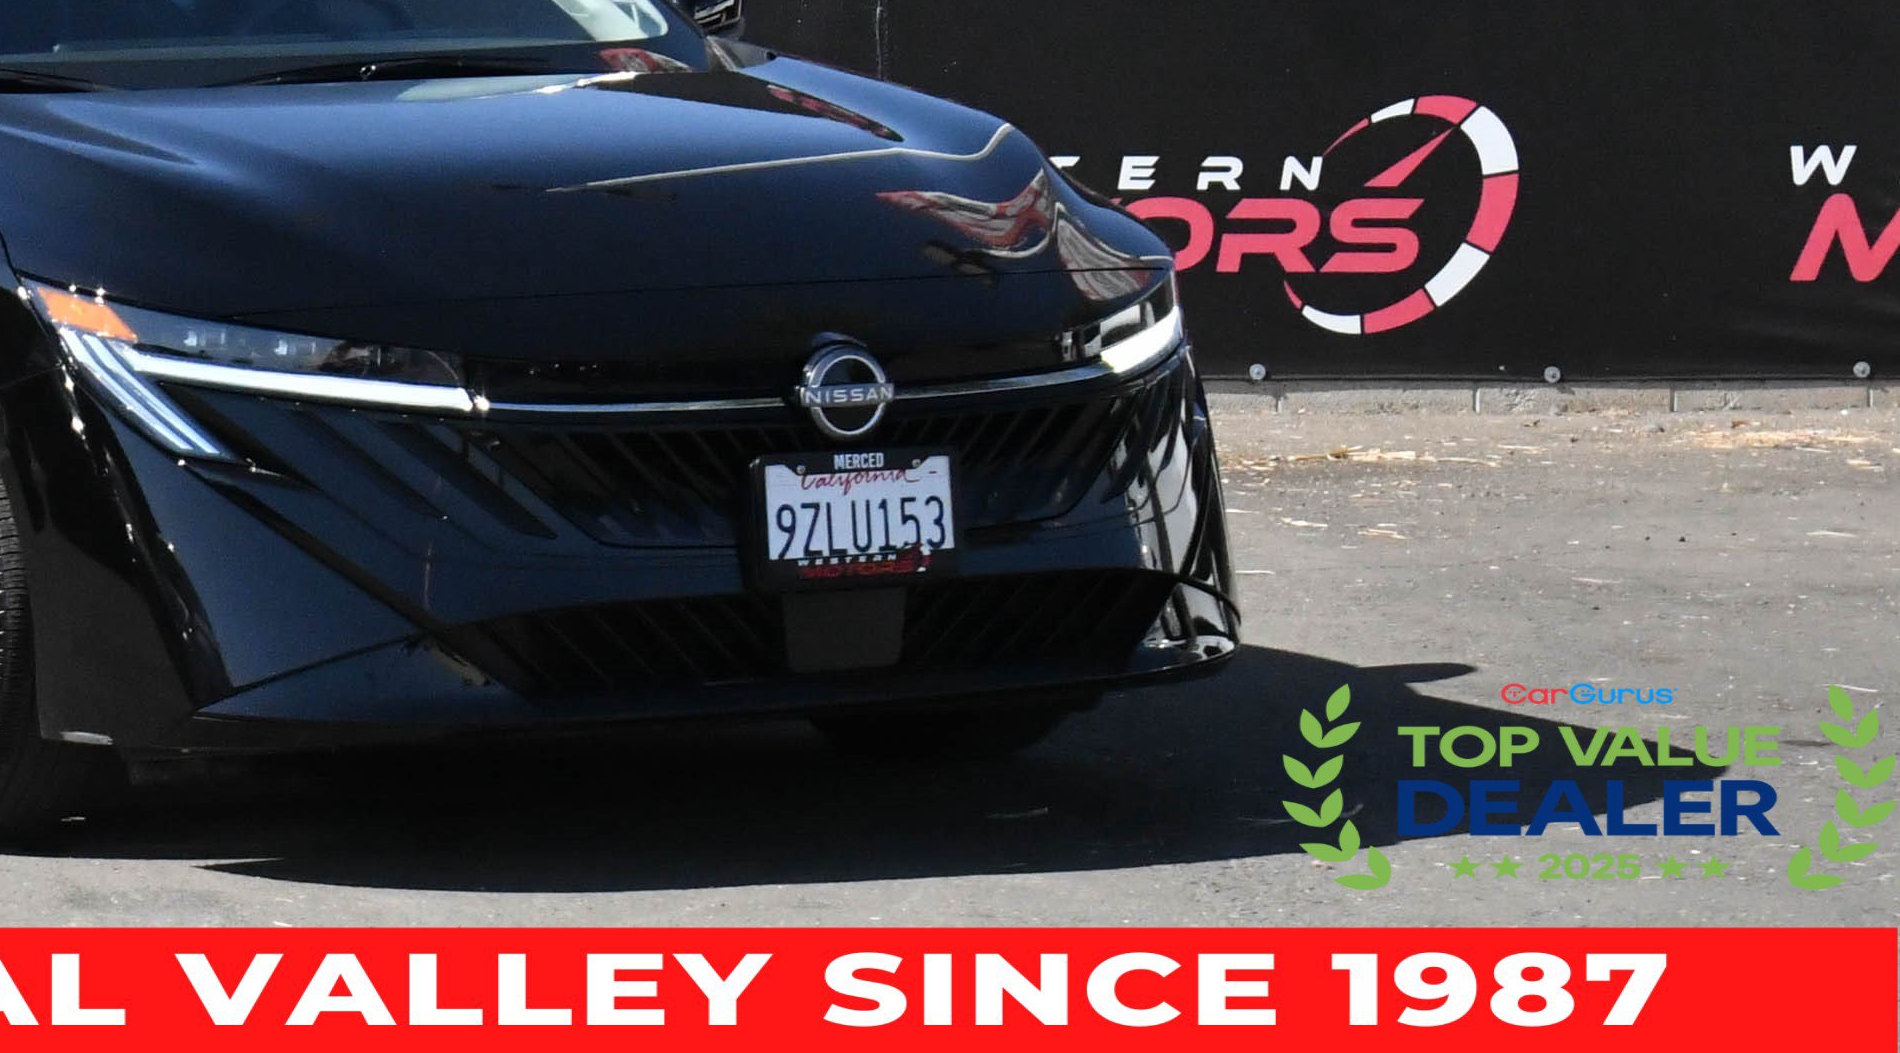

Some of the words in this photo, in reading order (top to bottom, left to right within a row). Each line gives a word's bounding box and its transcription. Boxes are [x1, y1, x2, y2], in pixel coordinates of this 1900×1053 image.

[1114, 197, 1424, 273] ORS
[805, 386, 894, 405] NISSAN
[833, 452, 885, 469] MERCED
[776, 496, 946, 559] 9ZLU153
[798, 554, 897, 567] WESTERN
